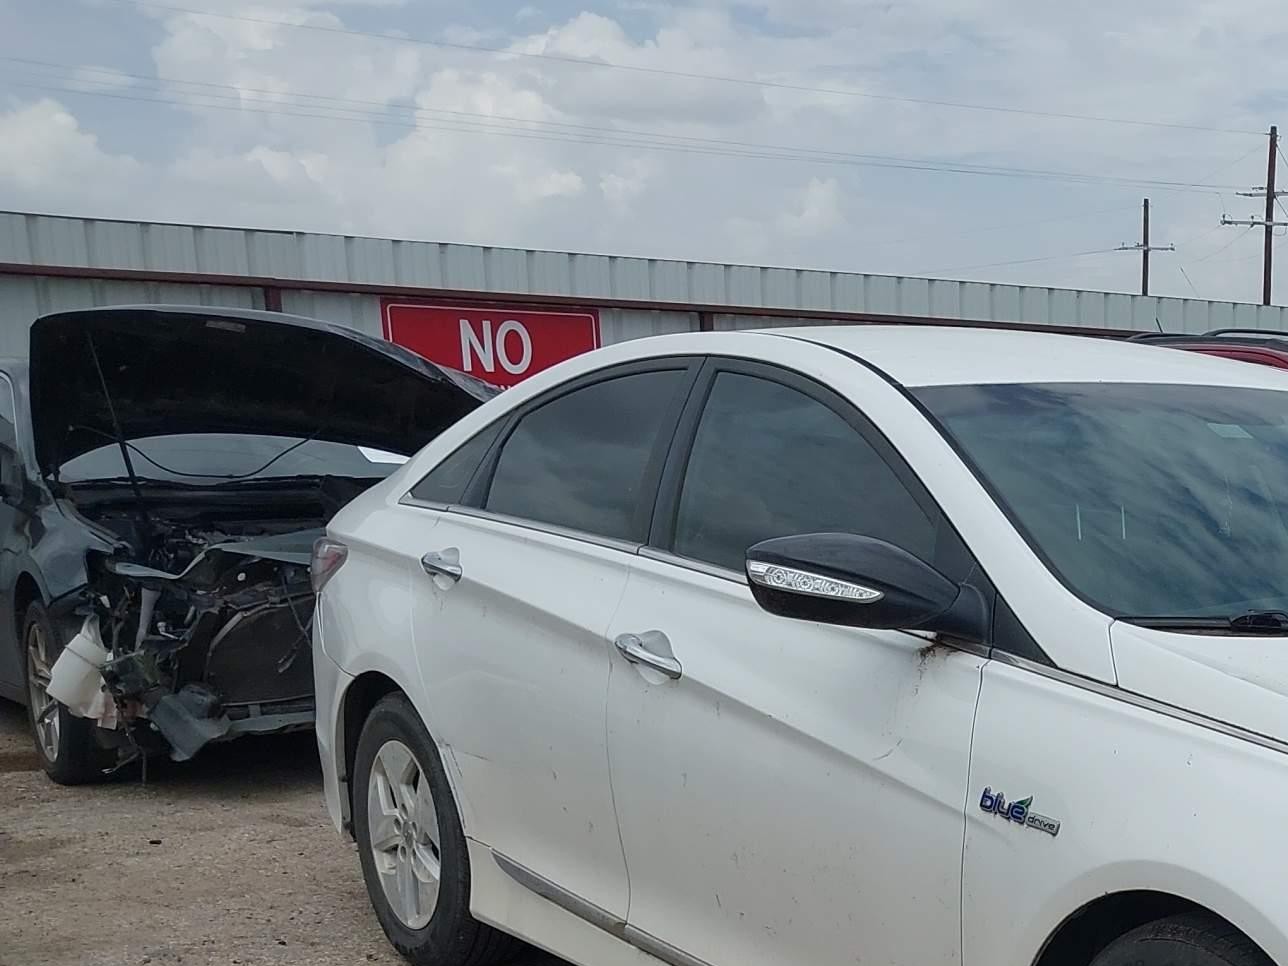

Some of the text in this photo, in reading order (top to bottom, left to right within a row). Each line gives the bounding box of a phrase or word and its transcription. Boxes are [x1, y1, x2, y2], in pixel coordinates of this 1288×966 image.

[459, 319, 532, 375] NO
[979, 785, 1056, 831] blue drive
